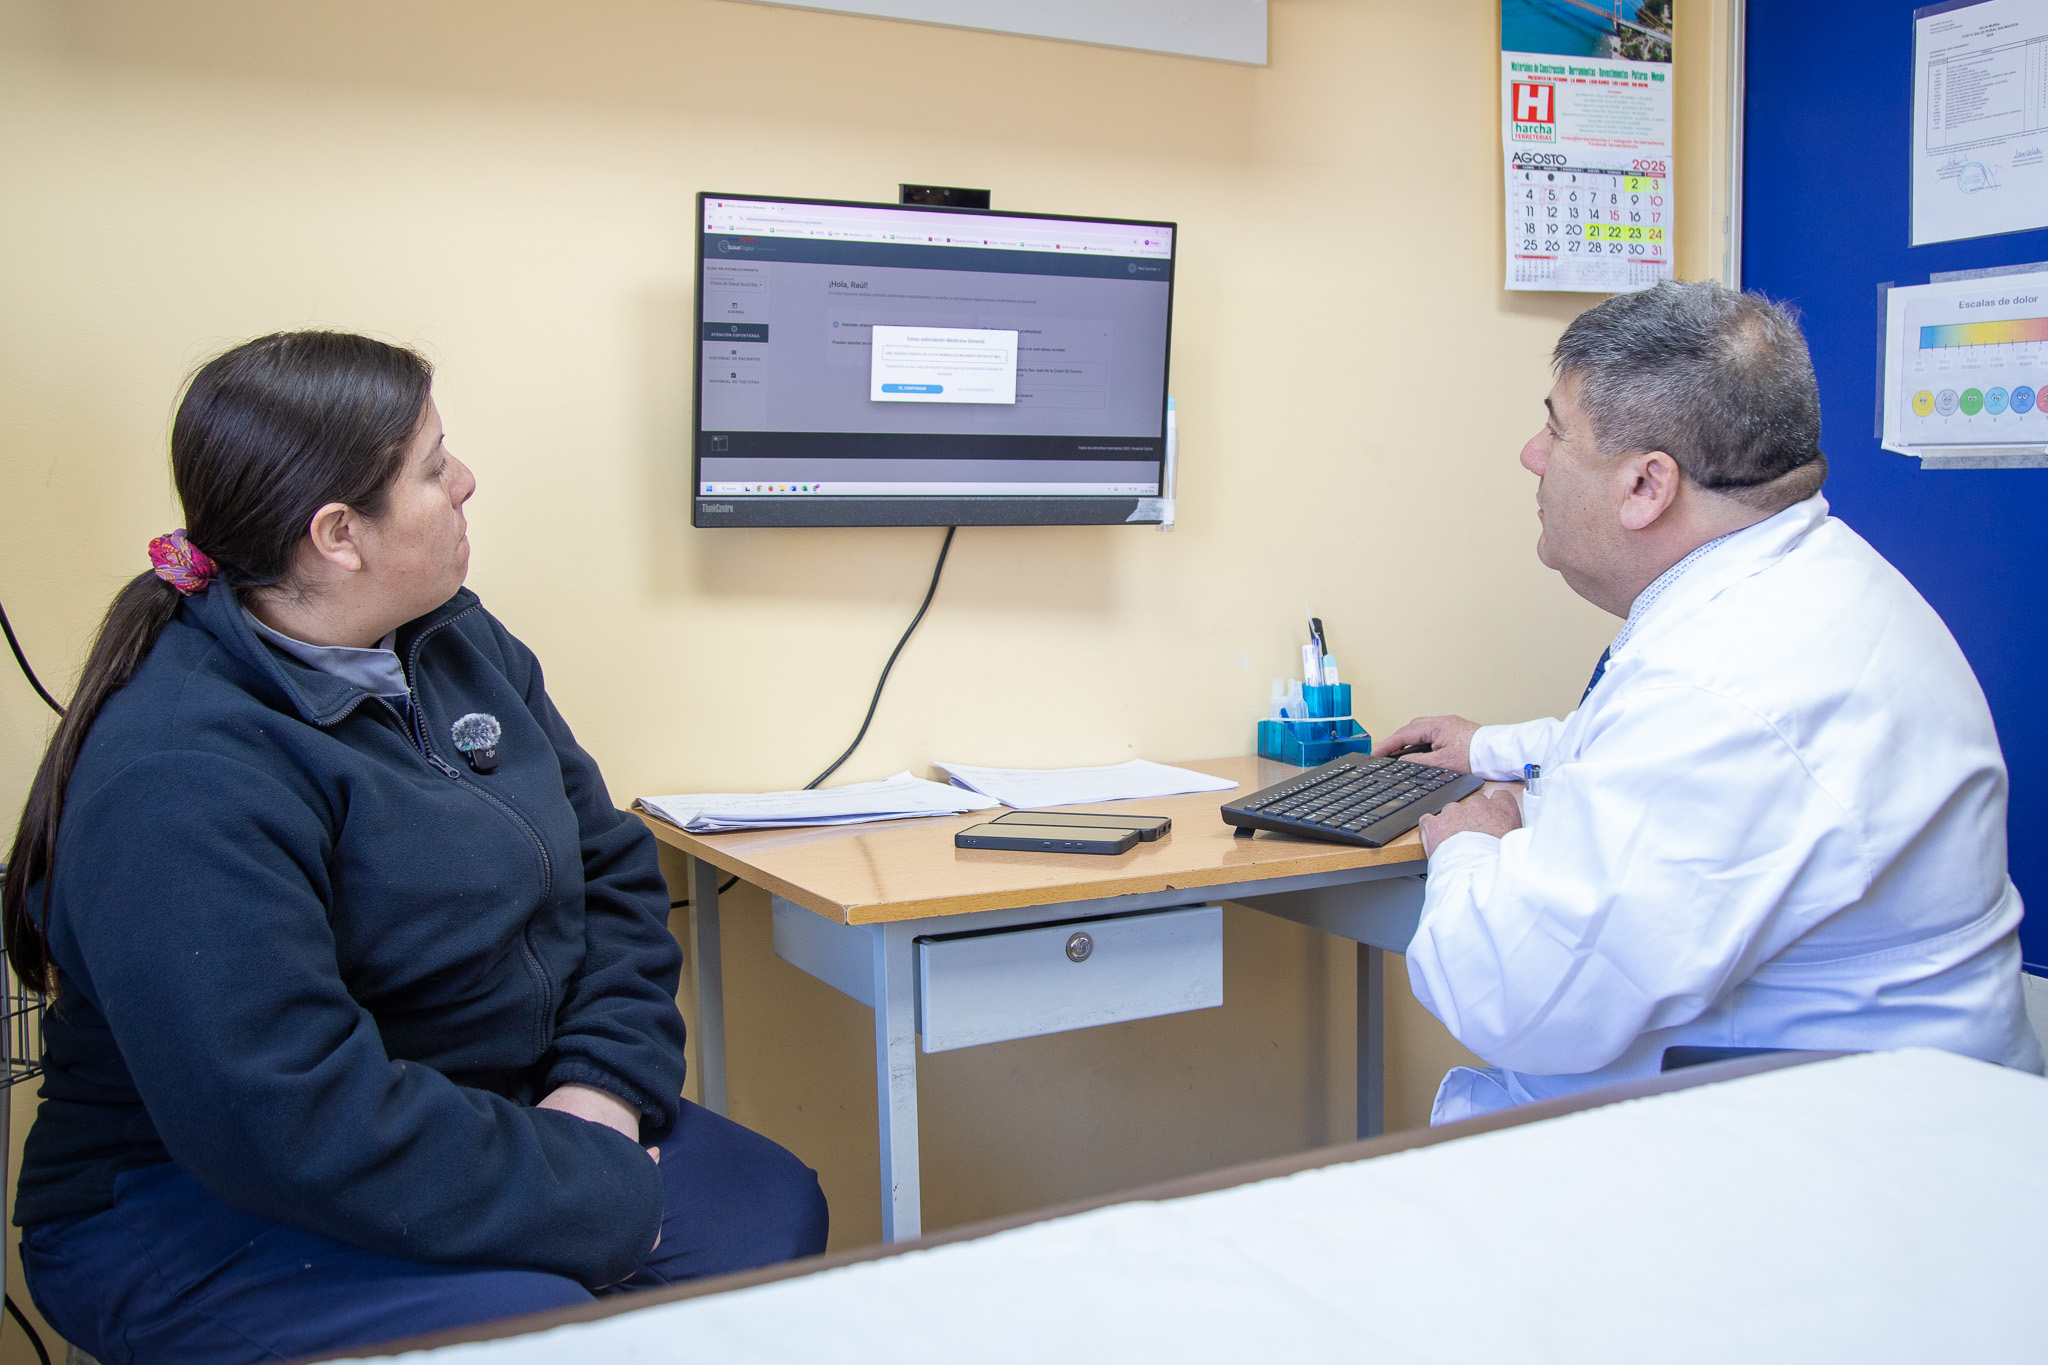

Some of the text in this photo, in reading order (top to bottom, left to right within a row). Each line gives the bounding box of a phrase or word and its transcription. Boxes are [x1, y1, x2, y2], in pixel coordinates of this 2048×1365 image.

[1511, 61, 1533, 72] Materiales
[1632, 69, 1648, 80] Pinturas
[1517, 85, 1549, 120] H
[1516, 121, 1552, 134] harcha
[1515, 133, 1552, 141] FERRETERIAS
[1512, 152, 1666, 171] AGOSTO 2025
[1612, 176, 1617, 187] 1
[1632, 178, 1639, 189] 2
[1652, 179, 1659, 190] 3
[1526, 189, 1663, 207] 4 5 6 7 8 9 10
[1526, 206, 1661, 223] 11 12 13 14 15 16 17
[1525, 223, 1662, 240] 18 19 20 21 22 23 24
[1524, 239, 1662, 256] 25 26 27 28 29 30 31
[1958, 295, 2039, 309] Escalas de dolor
[702, 504, 734, 513] ThinkCentre
[486, 750, 496, 758] dji
